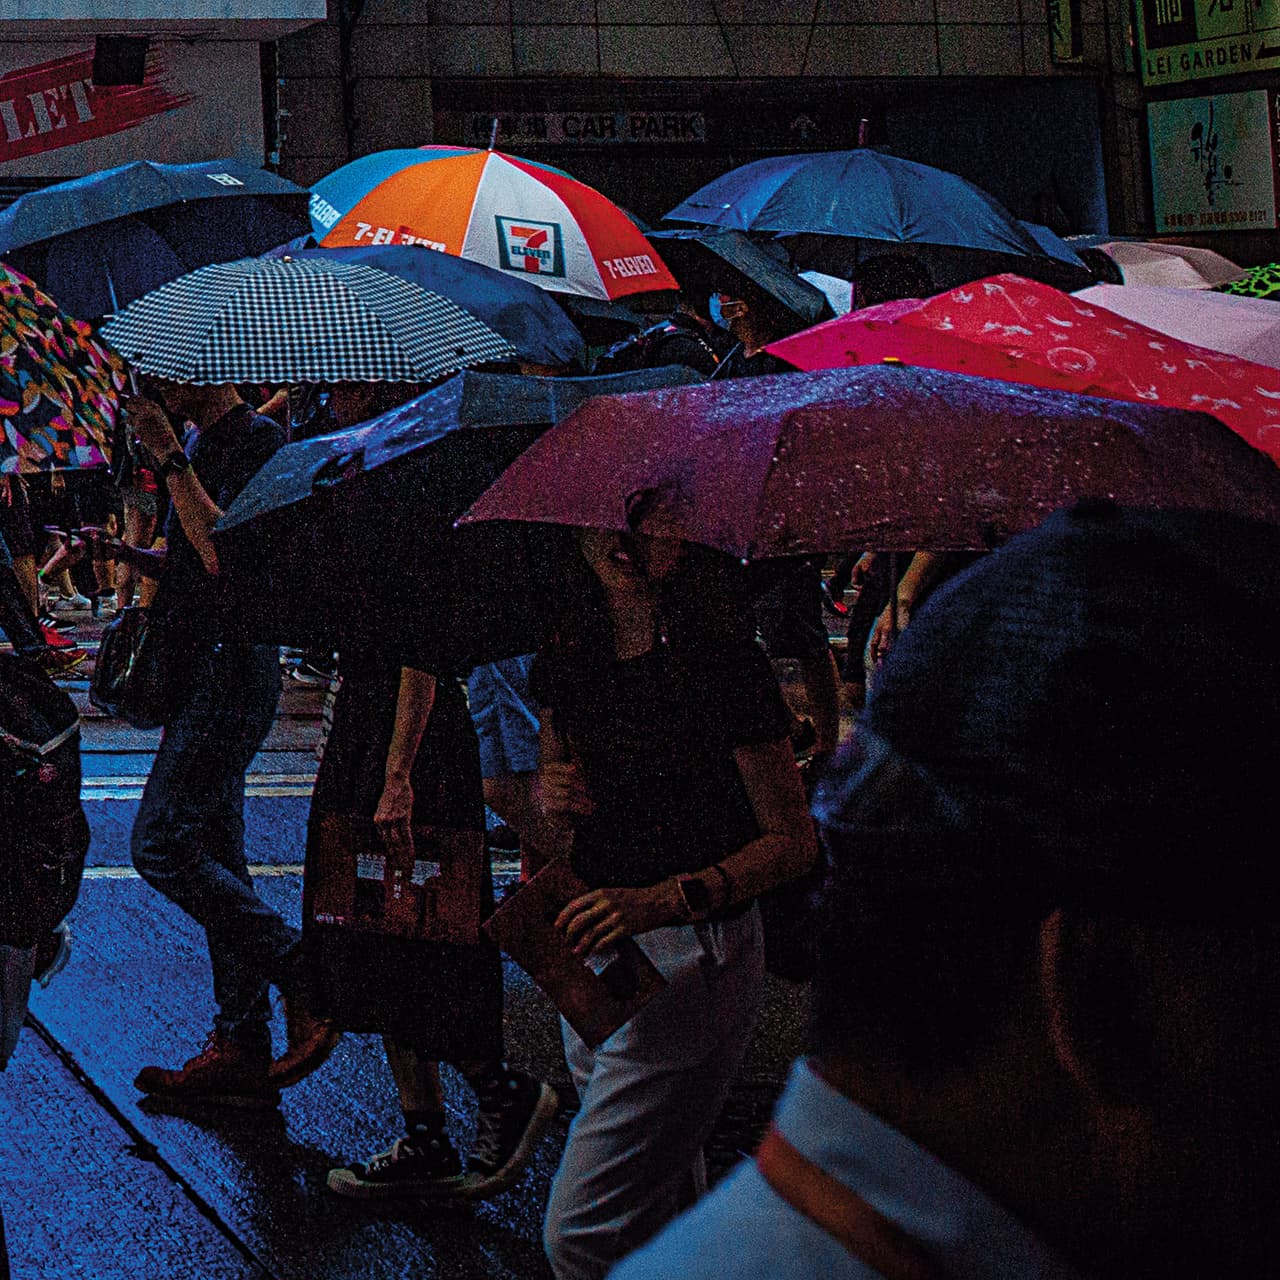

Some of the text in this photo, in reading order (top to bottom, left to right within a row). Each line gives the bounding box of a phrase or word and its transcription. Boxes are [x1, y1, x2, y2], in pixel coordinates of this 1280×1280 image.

[1147, 42, 1252, 76] LEI GARDEN
[561, 116, 617, 138] CAR
[630, 116, 700, 138] PARK
